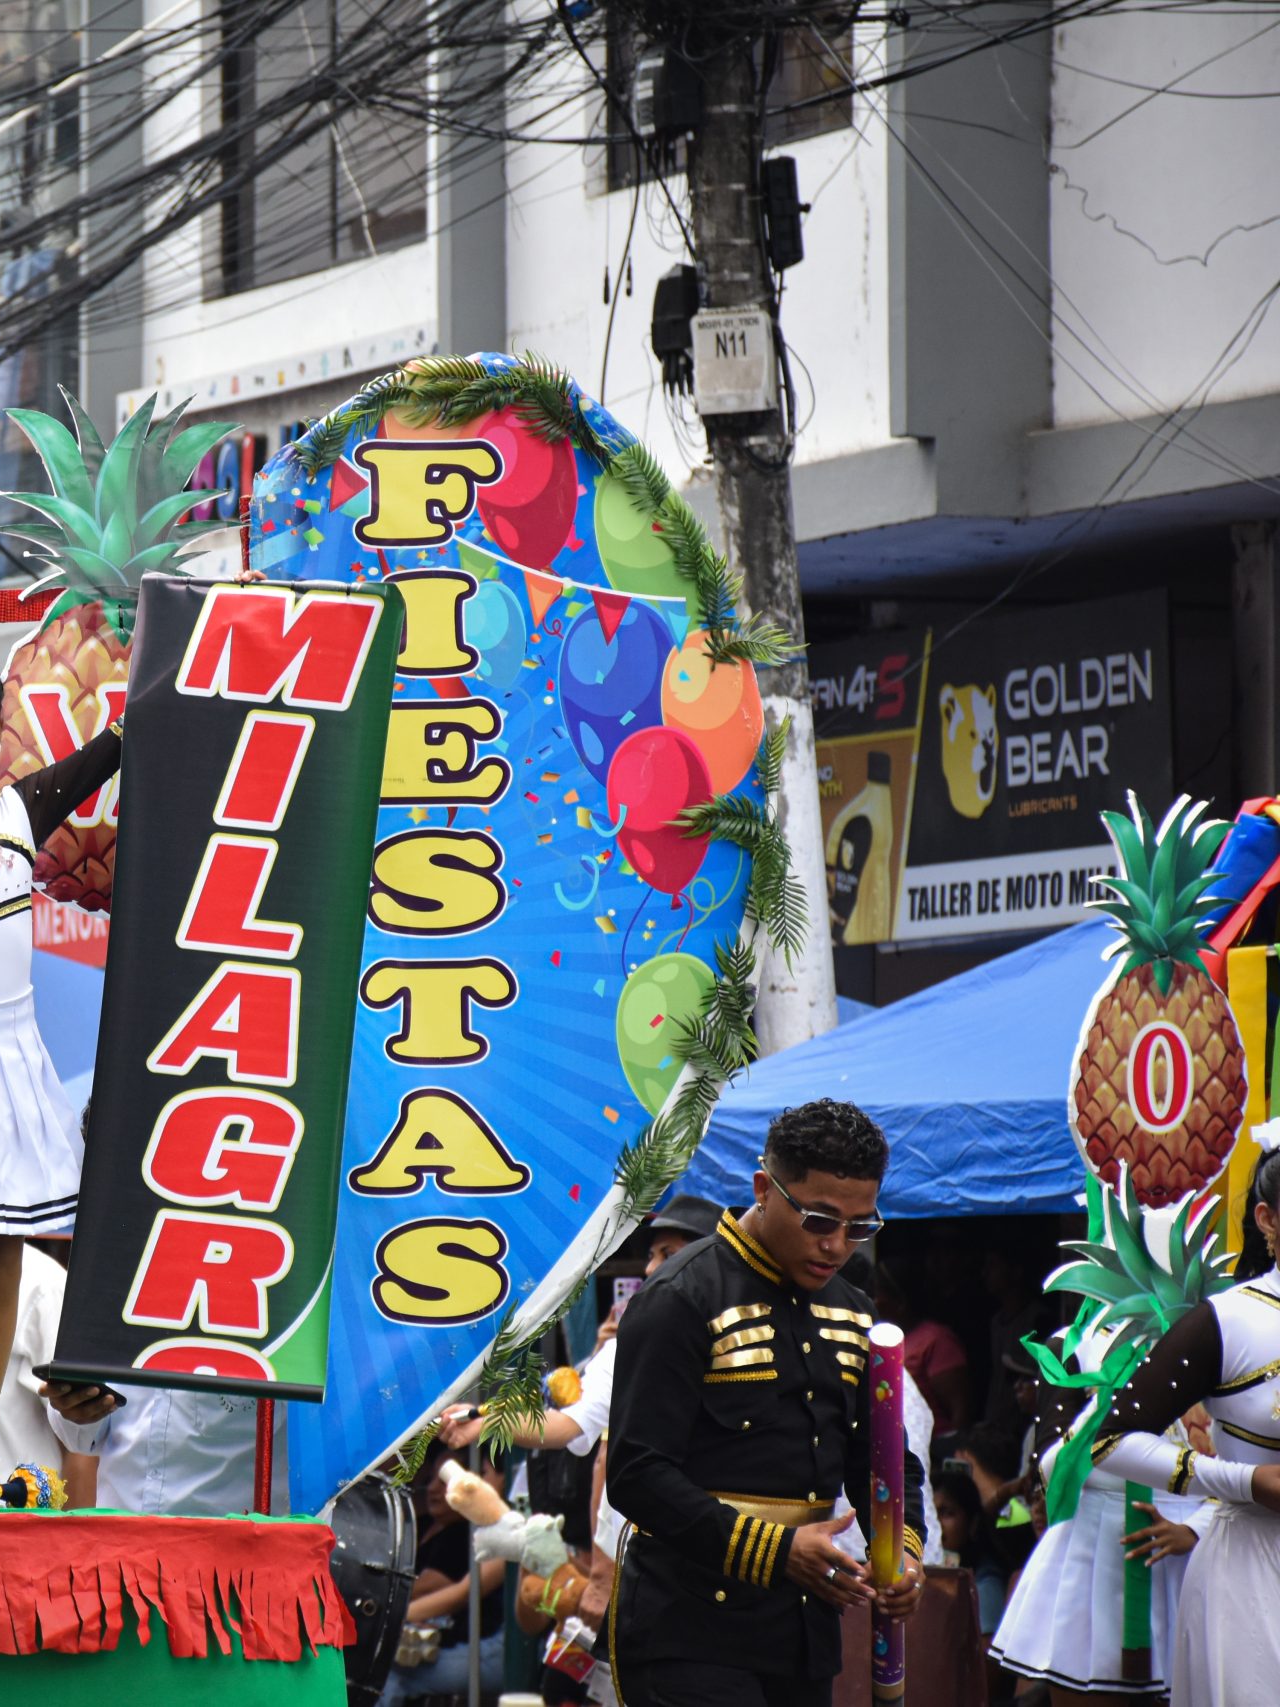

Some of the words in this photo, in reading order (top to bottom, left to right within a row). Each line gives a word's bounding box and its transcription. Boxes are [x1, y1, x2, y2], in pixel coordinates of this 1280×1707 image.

[715, 330, 747, 359] N11
[1004, 649, 1153, 721] GOLDEN
[1006, 724, 1110, 787] BEAR
[1008, 795, 1078, 818] LUBRICANTS
[349, 440, 531, 1327] FIESTAS
[908, 879, 972, 923] TALLER
[977, 876, 1001, 915] DE
[1006, 870, 1064, 912] MOTO
